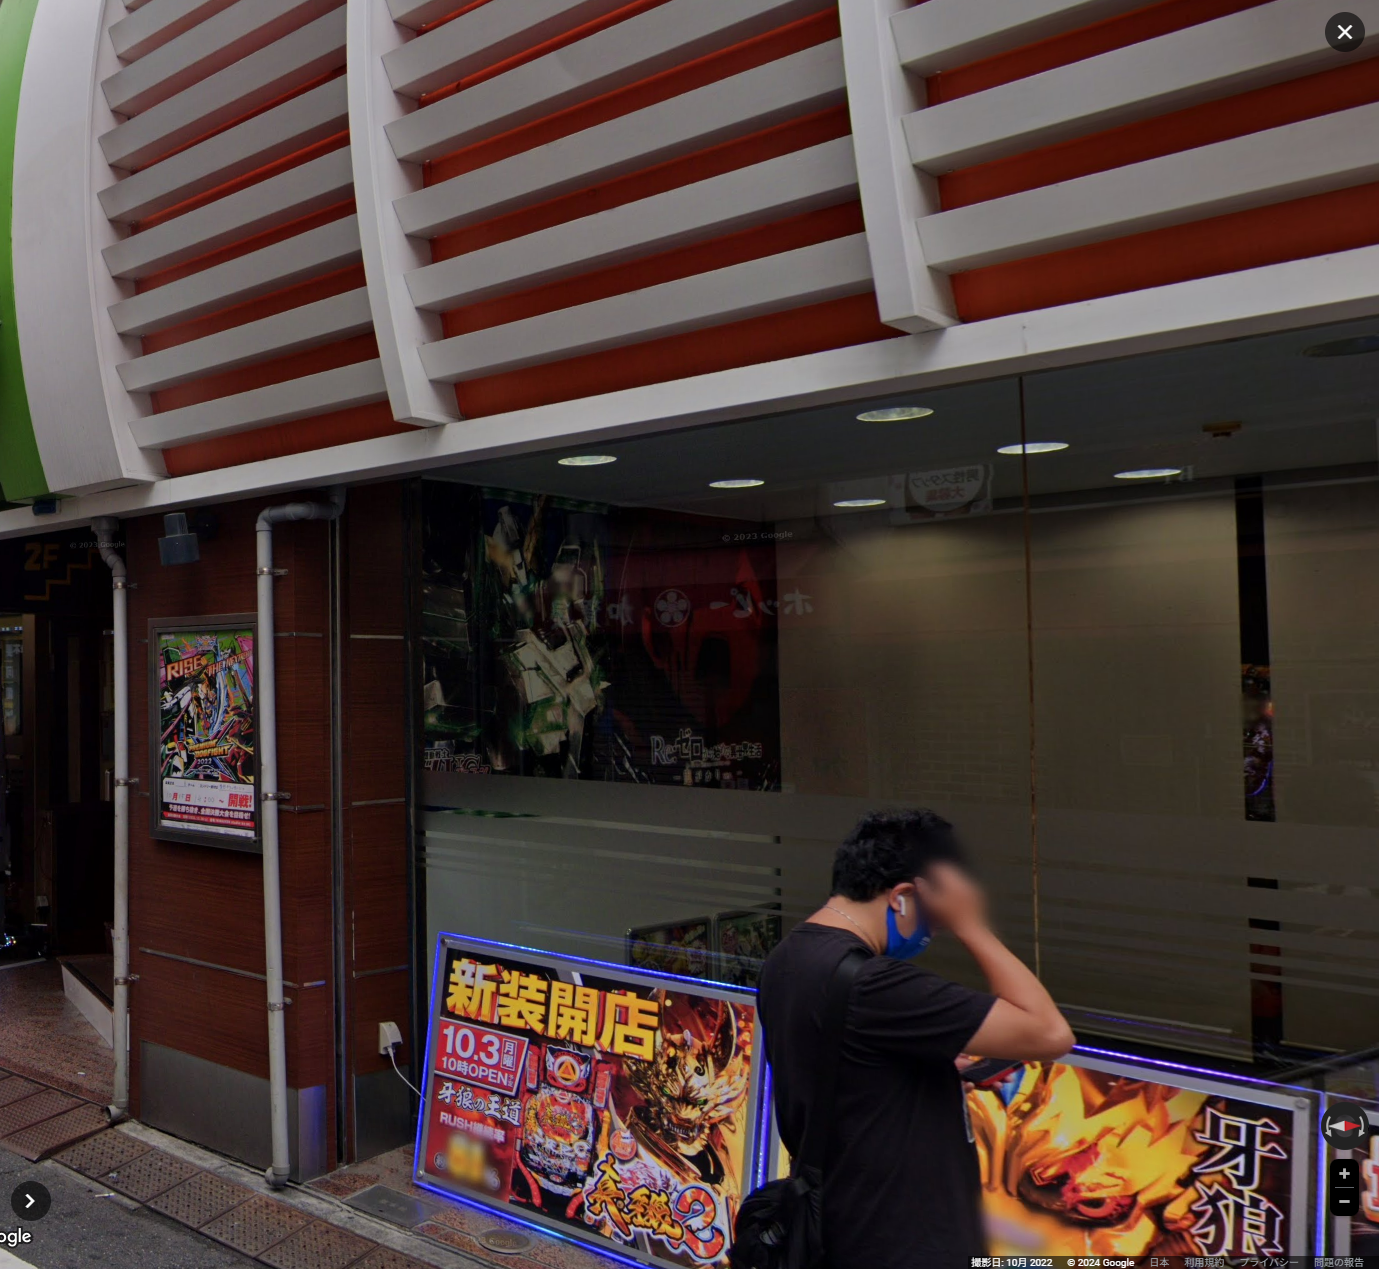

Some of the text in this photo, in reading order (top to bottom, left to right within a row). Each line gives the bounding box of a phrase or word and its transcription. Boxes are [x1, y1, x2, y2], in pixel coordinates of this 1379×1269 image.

[25, 544, 60, 570] 2F
[166, 655, 202, 681] RISE
[228, 793, 253, 809] 開戦!
[445, 957, 660, 1063] 新装開店
[443, 1025, 501, 1066] 10.3
[502, 1038, 516, 1071] 月曜
[441, 1056, 508, 1087] 10時OPEN
[438, 1082, 522, 1126] 牙狼の王道
[1192, 1106, 1289, 1258] 牙狼
